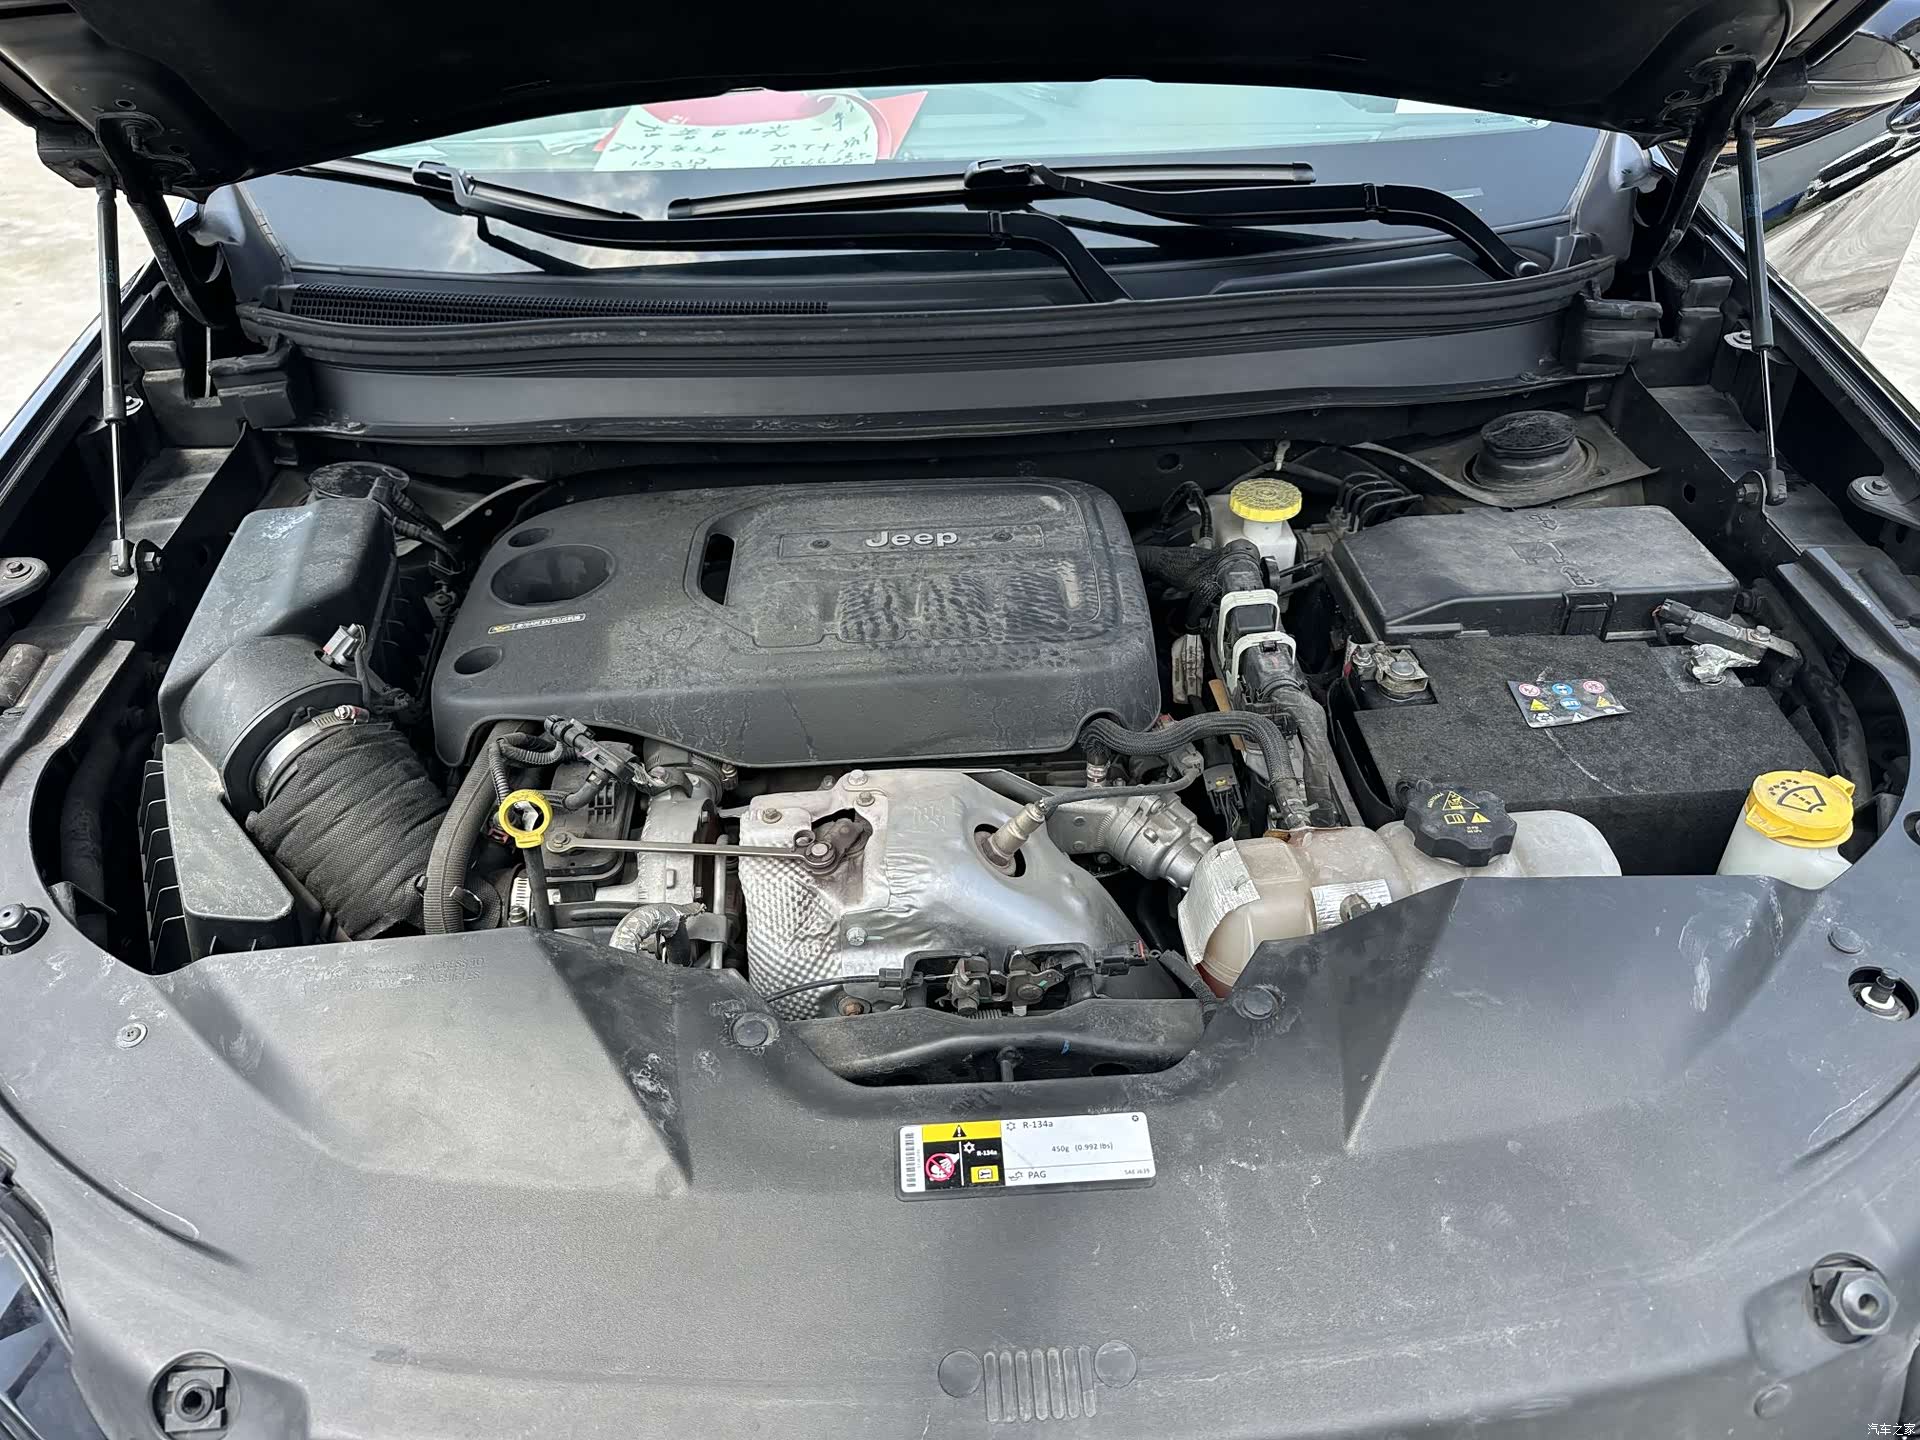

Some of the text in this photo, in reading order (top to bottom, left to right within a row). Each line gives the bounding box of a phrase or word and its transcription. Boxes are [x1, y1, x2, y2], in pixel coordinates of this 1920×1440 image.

[865, 530, 958, 547] Jeep
[1022, 1120, 1054, 1129] R-134a
[1052, 1142, 1114, 1153] 450g (0.992 lbs)
[976, 1149, 998, 1157] R-134a
[1027, 1171, 1047, 1180] PAG
